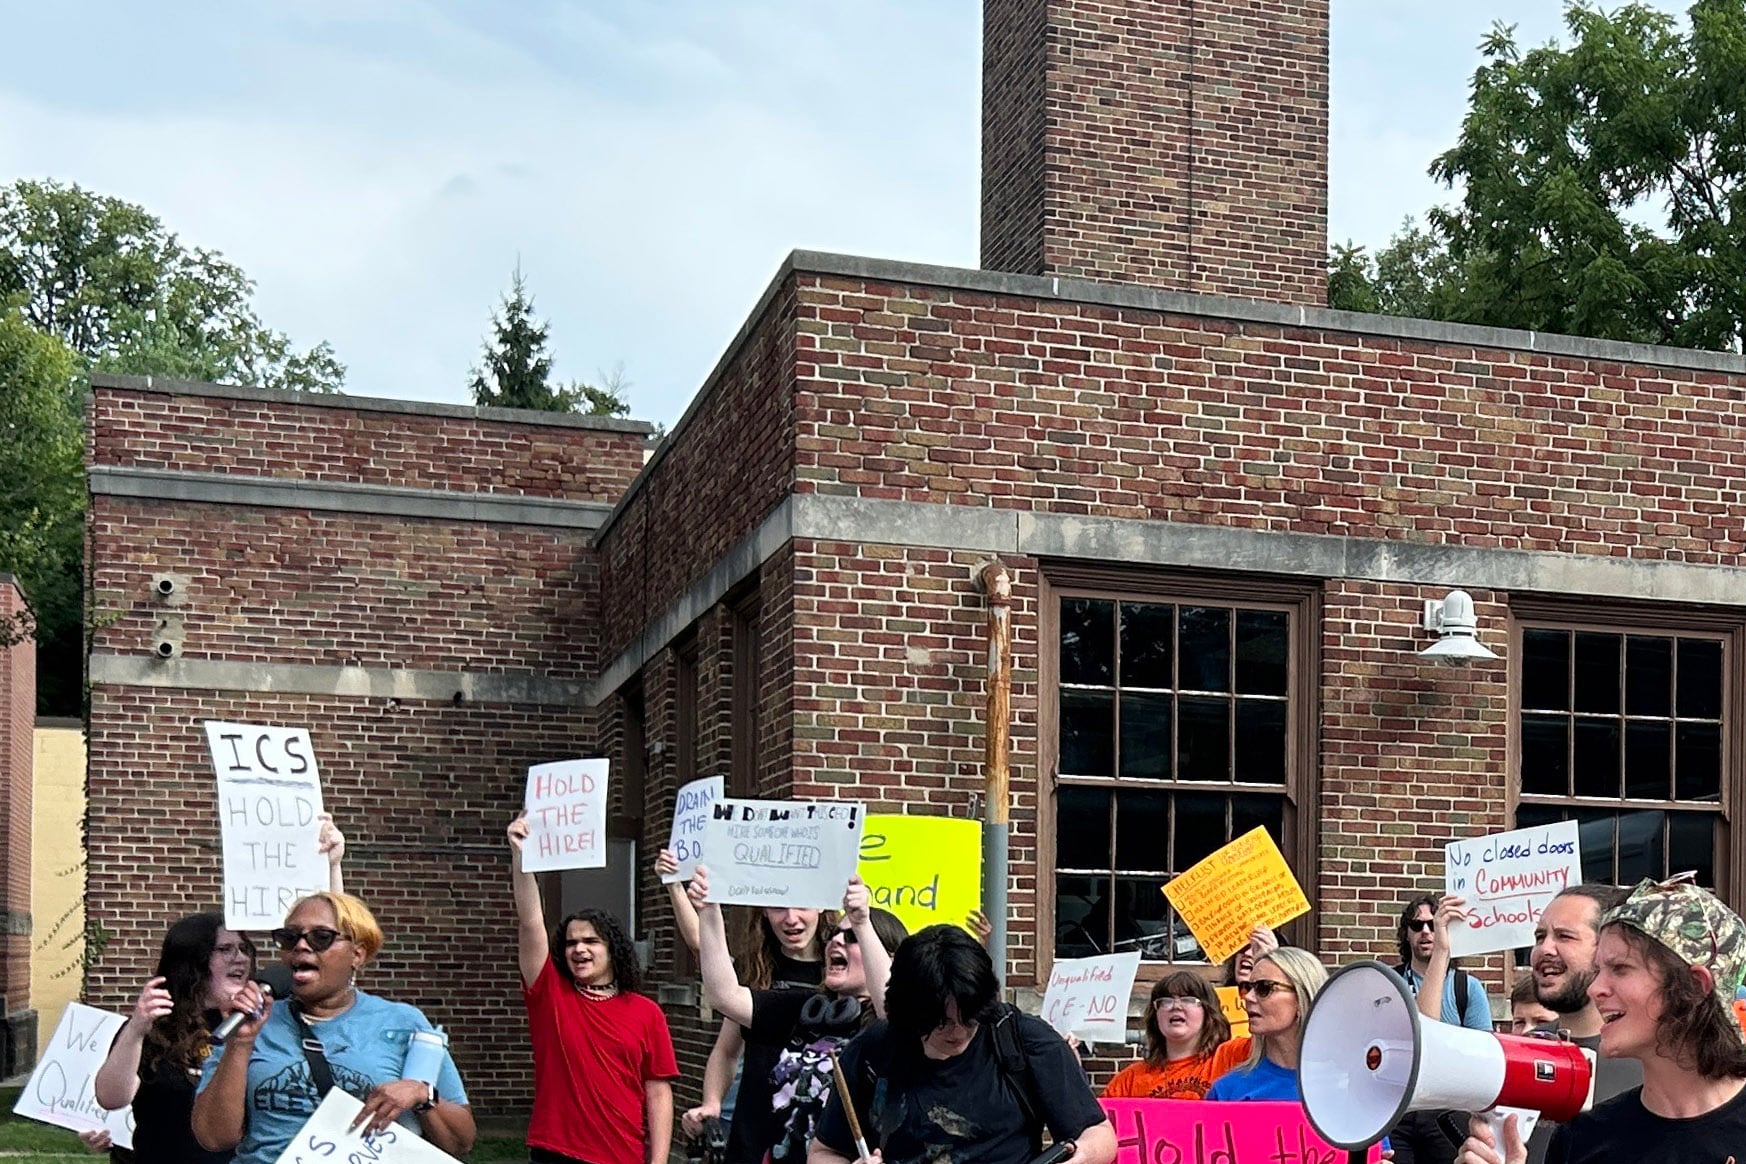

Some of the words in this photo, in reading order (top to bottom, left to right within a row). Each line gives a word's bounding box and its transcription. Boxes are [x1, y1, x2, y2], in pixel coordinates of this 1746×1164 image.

[221, 734, 308, 774] ICS
[535, 773, 595, 800] HOLD
[677, 786, 714, 815] DRAIN
[228, 797, 313, 827] HOLD
[536, 803, 588, 828] THE
[680, 815, 707, 835] THE
[243, 842, 297, 870] THE
[539, 830, 595, 858] HIRE!
[734, 843, 821, 866] QUALIFIED
[1450, 844, 1471, 867] No
[1483, 838, 1531, 863] closed
[1537, 832, 1574, 855] doors
[1453, 872, 1466, 891] in
[231, 886, 313, 917] HIR
[67, 1010, 108, 1053] We
